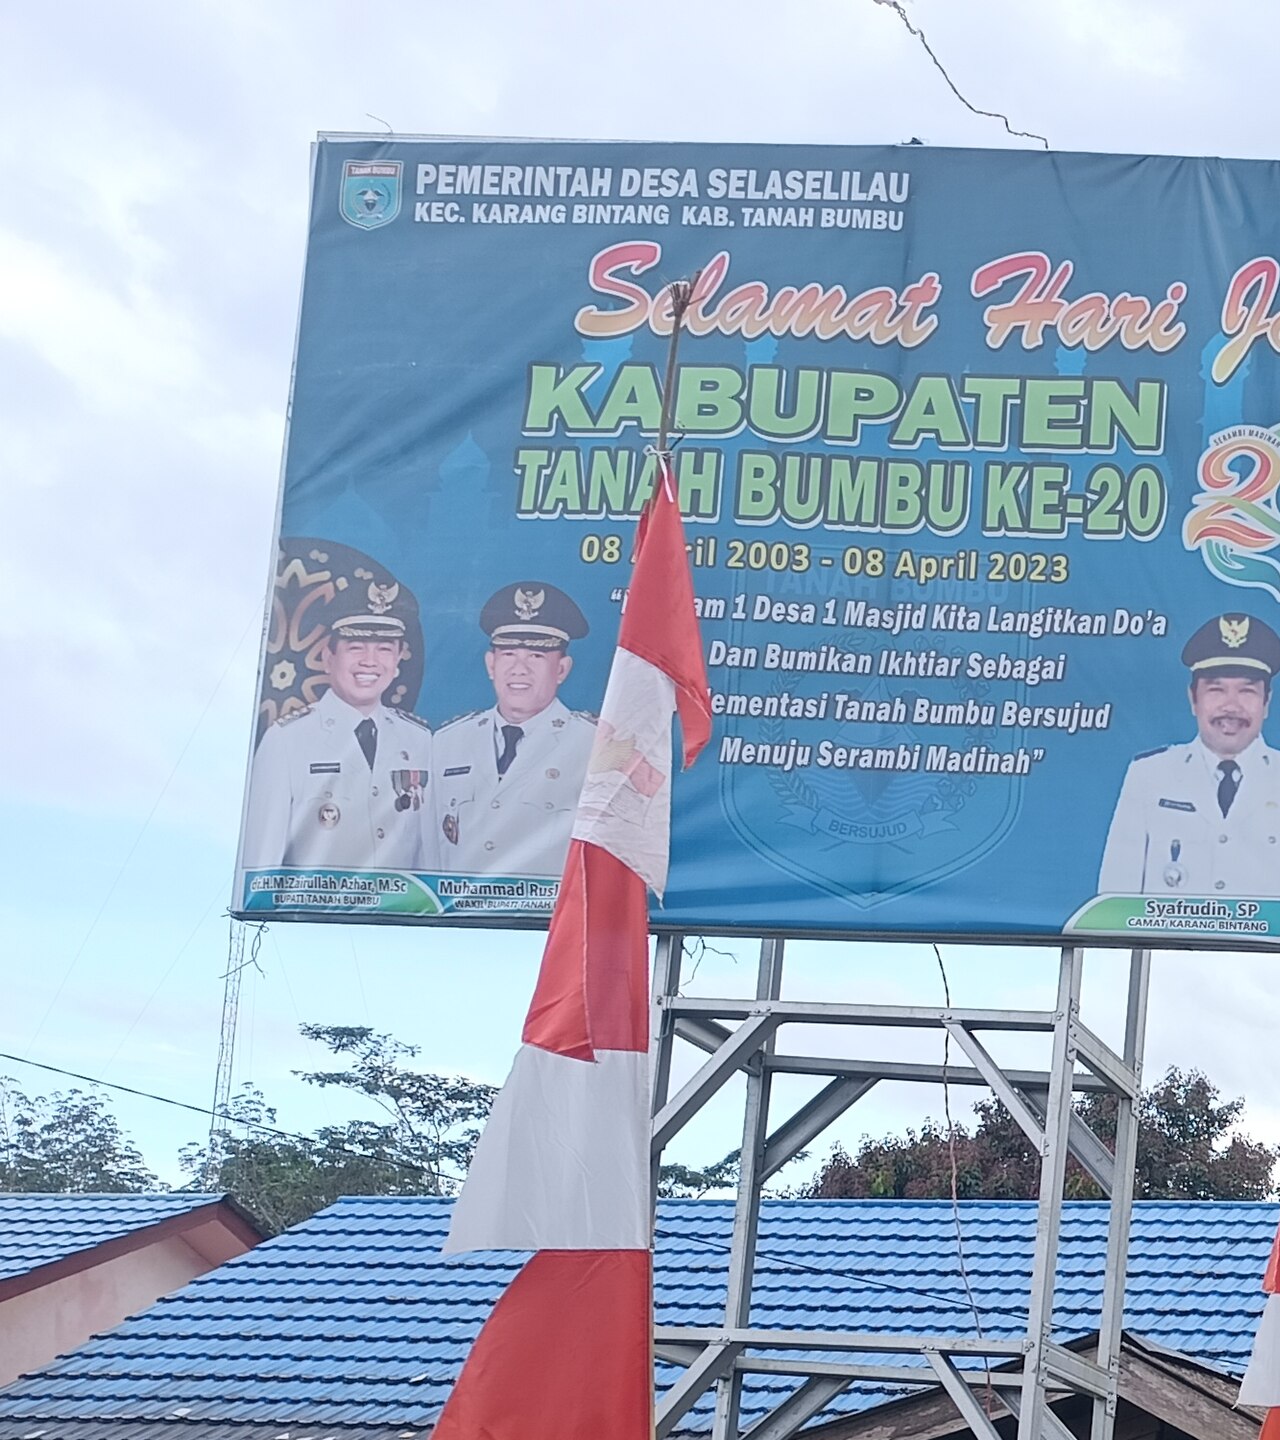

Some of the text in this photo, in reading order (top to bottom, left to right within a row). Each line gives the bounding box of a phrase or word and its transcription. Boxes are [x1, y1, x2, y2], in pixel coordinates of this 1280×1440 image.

[416, 164, 910, 203] PEMERINTAH DESA SELASELILAU
[414, 202, 904, 231] KEC. KARANG BINTANG KAB. TANAH BUMBU
[574, 241, 941, 348] Selamat
[970, 251, 1187, 352] Hari
[521, 361, 1167, 456] KABUPATEN
[514, 446, 1167, 541] TANAH BUMBU KE-20
[581, 534, 622, 564] 08
[727, 540, 810, 572] 2003
[843, 548, 885, 577] 08
[894, 550, 978, 584] April
[988, 552, 1069, 582] 2023
[731, 593, 747, 620] 1
[753, 595, 814, 624] Desa
[821, 599, 837, 625] 1
[843, 600, 927, 635] Masjid
[931, 604, 981, 631] Kita
[987, 606, 1106, 638] Langitkan
[708, 640, 1066, 685] Dan Bumikan Ikhtiar Sebagai
[707, 688, 1111, 734] ementasi Tanah Bumbu Bersujud
[719, 736, 810, 771] Menuju
[816, 740, 919, 770] Serambi
[828, 820, 907, 839] BERSUJUD
[439, 880, 525, 896] Muhammad
[1128, 919, 1267, 932] CAMAT KARANG BINTANG
[1147, 901, 1258, 918] Syafrudin, SP
